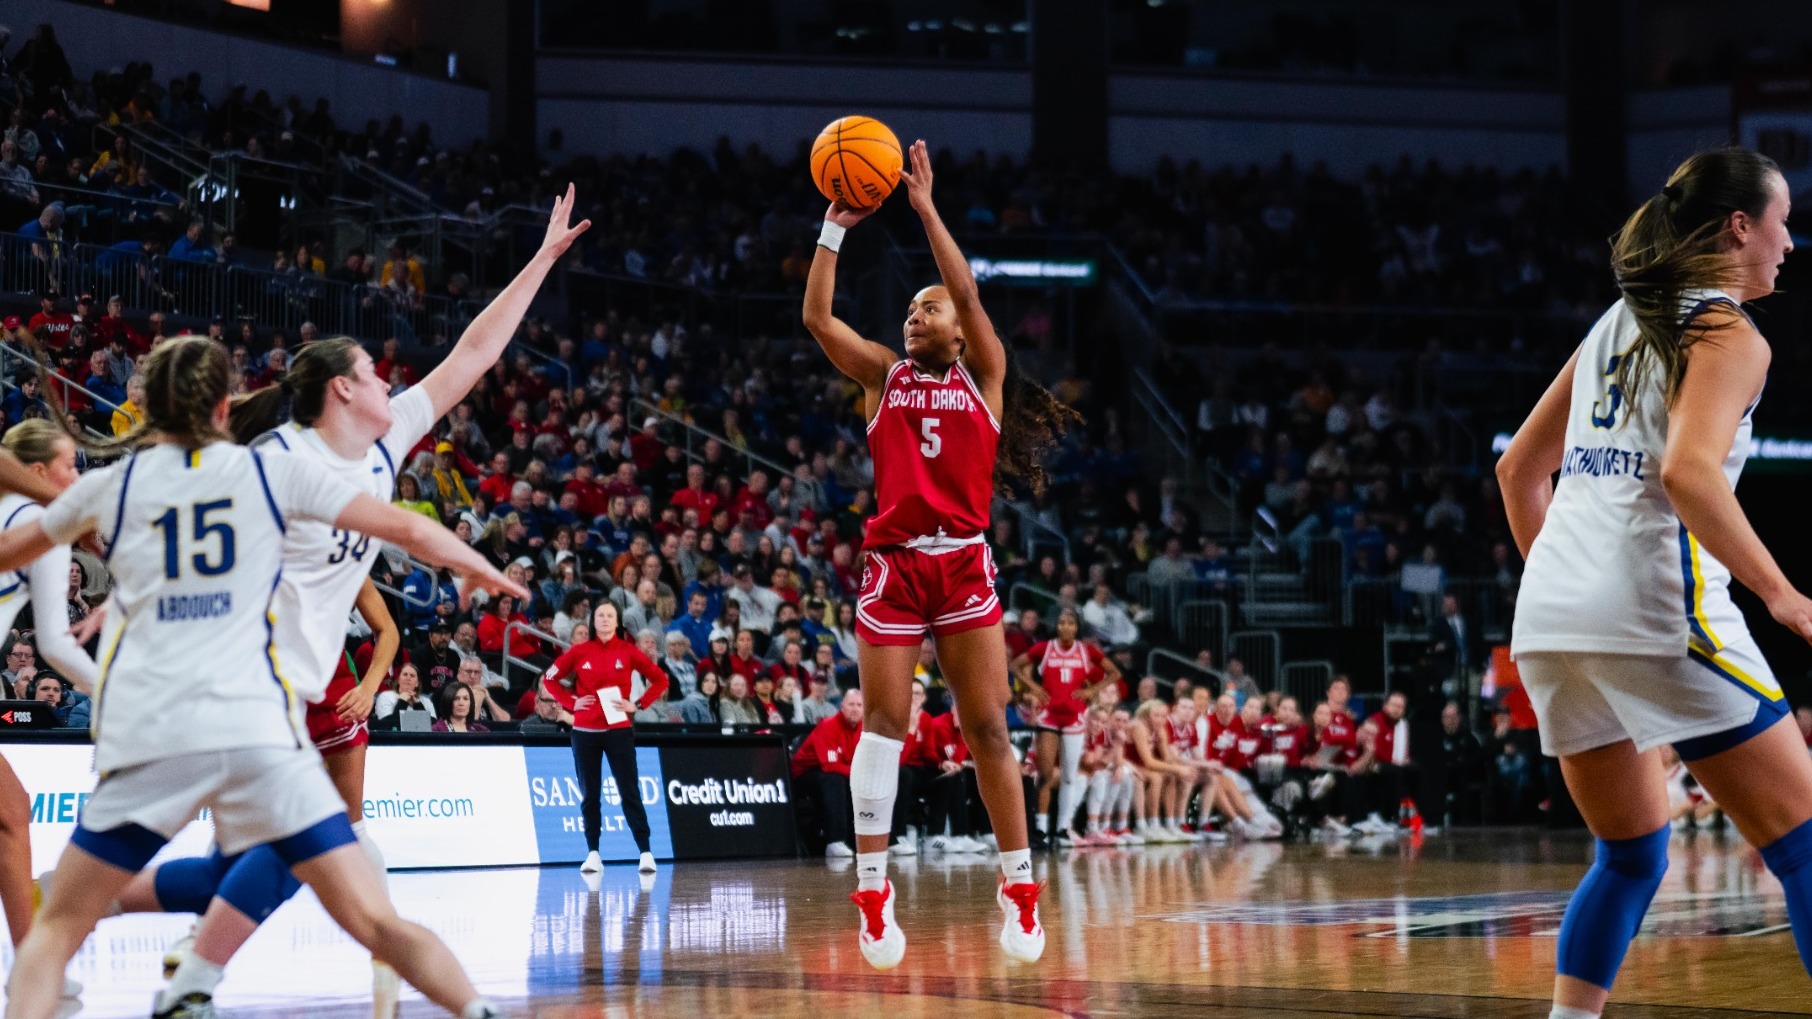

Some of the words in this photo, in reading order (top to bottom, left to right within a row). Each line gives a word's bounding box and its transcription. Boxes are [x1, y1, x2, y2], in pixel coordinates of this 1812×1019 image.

[888, 389, 926, 409] SOUTH
[920, 418, 941, 458] 5
[152, 498, 236, 580] 15
[328, 527, 370, 565] 34
[14, 711, 32, 722] POSS
[668, 777, 725, 805] Credit
[709, 809, 755, 826] cu1.com
